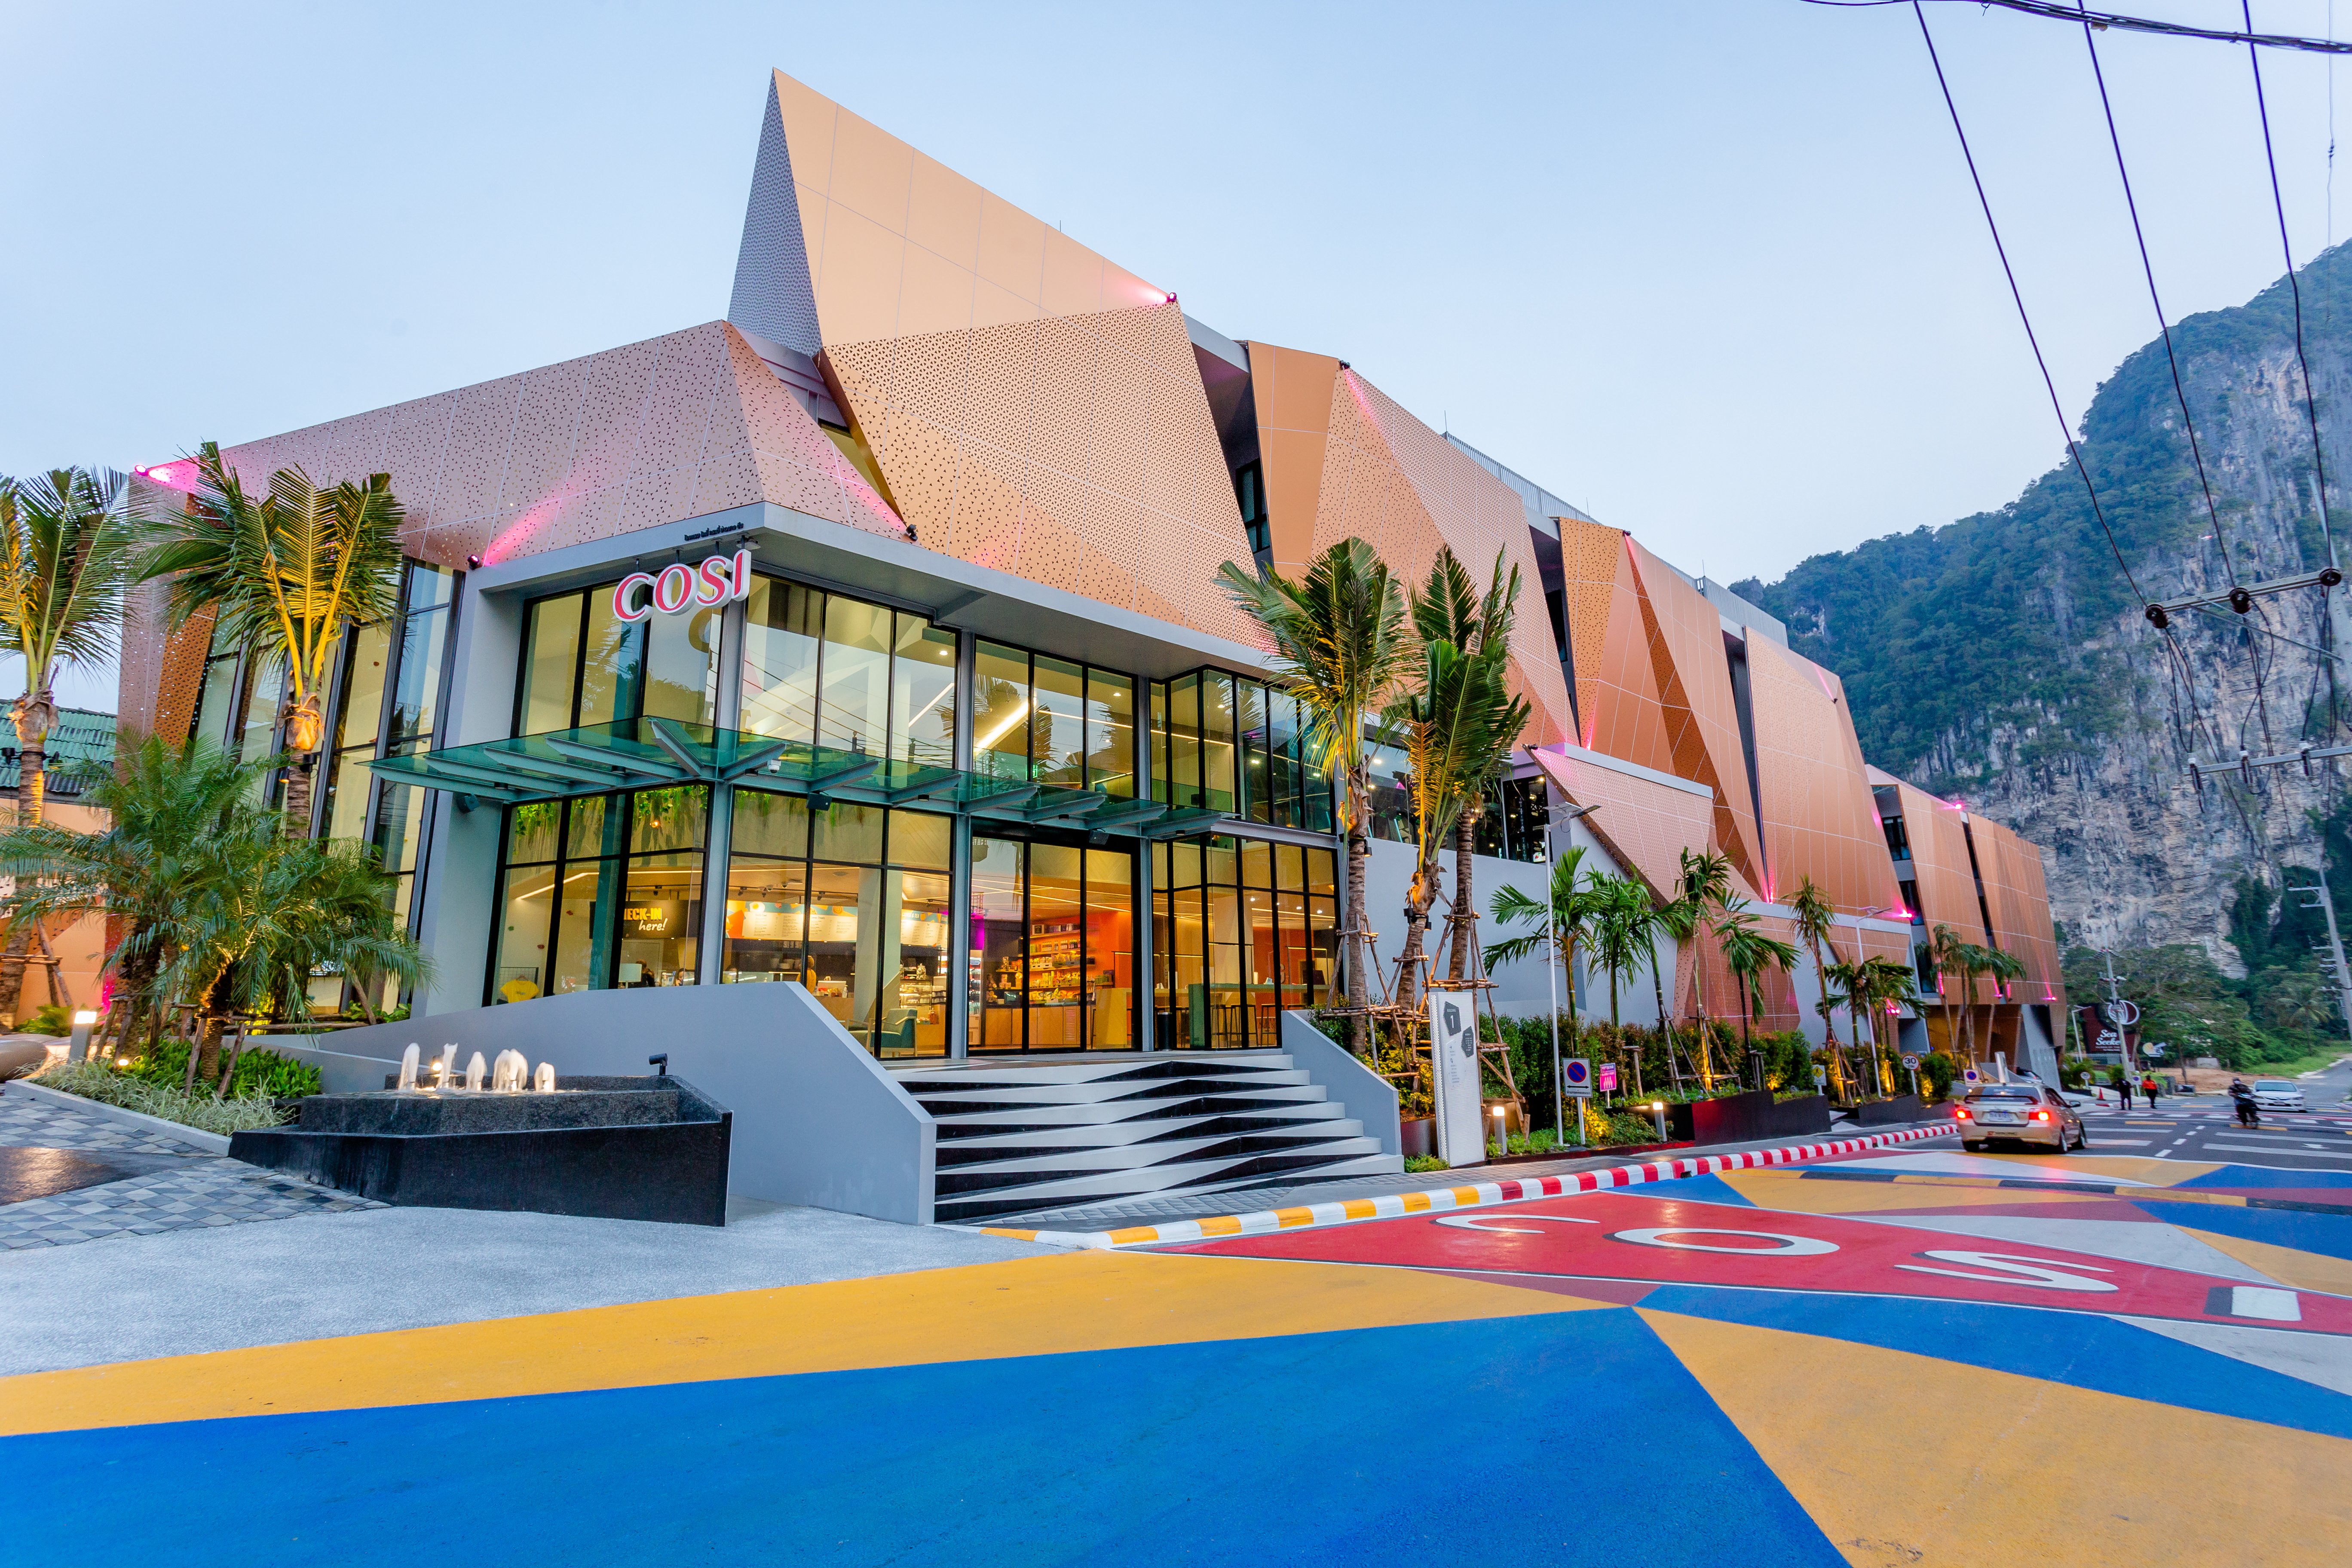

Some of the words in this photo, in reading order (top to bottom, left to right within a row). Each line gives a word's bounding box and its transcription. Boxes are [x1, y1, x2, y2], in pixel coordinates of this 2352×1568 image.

[612, 549, 751, 623] COSI
[638, 918, 668, 931] here!
[1450, 1015, 1454, 1029] 1
[2100, 1029, 2117, 1038] Sea
[2096, 1037, 2121, 1045] Seeke
[1433, 1213, 2302, 1321] COSI
